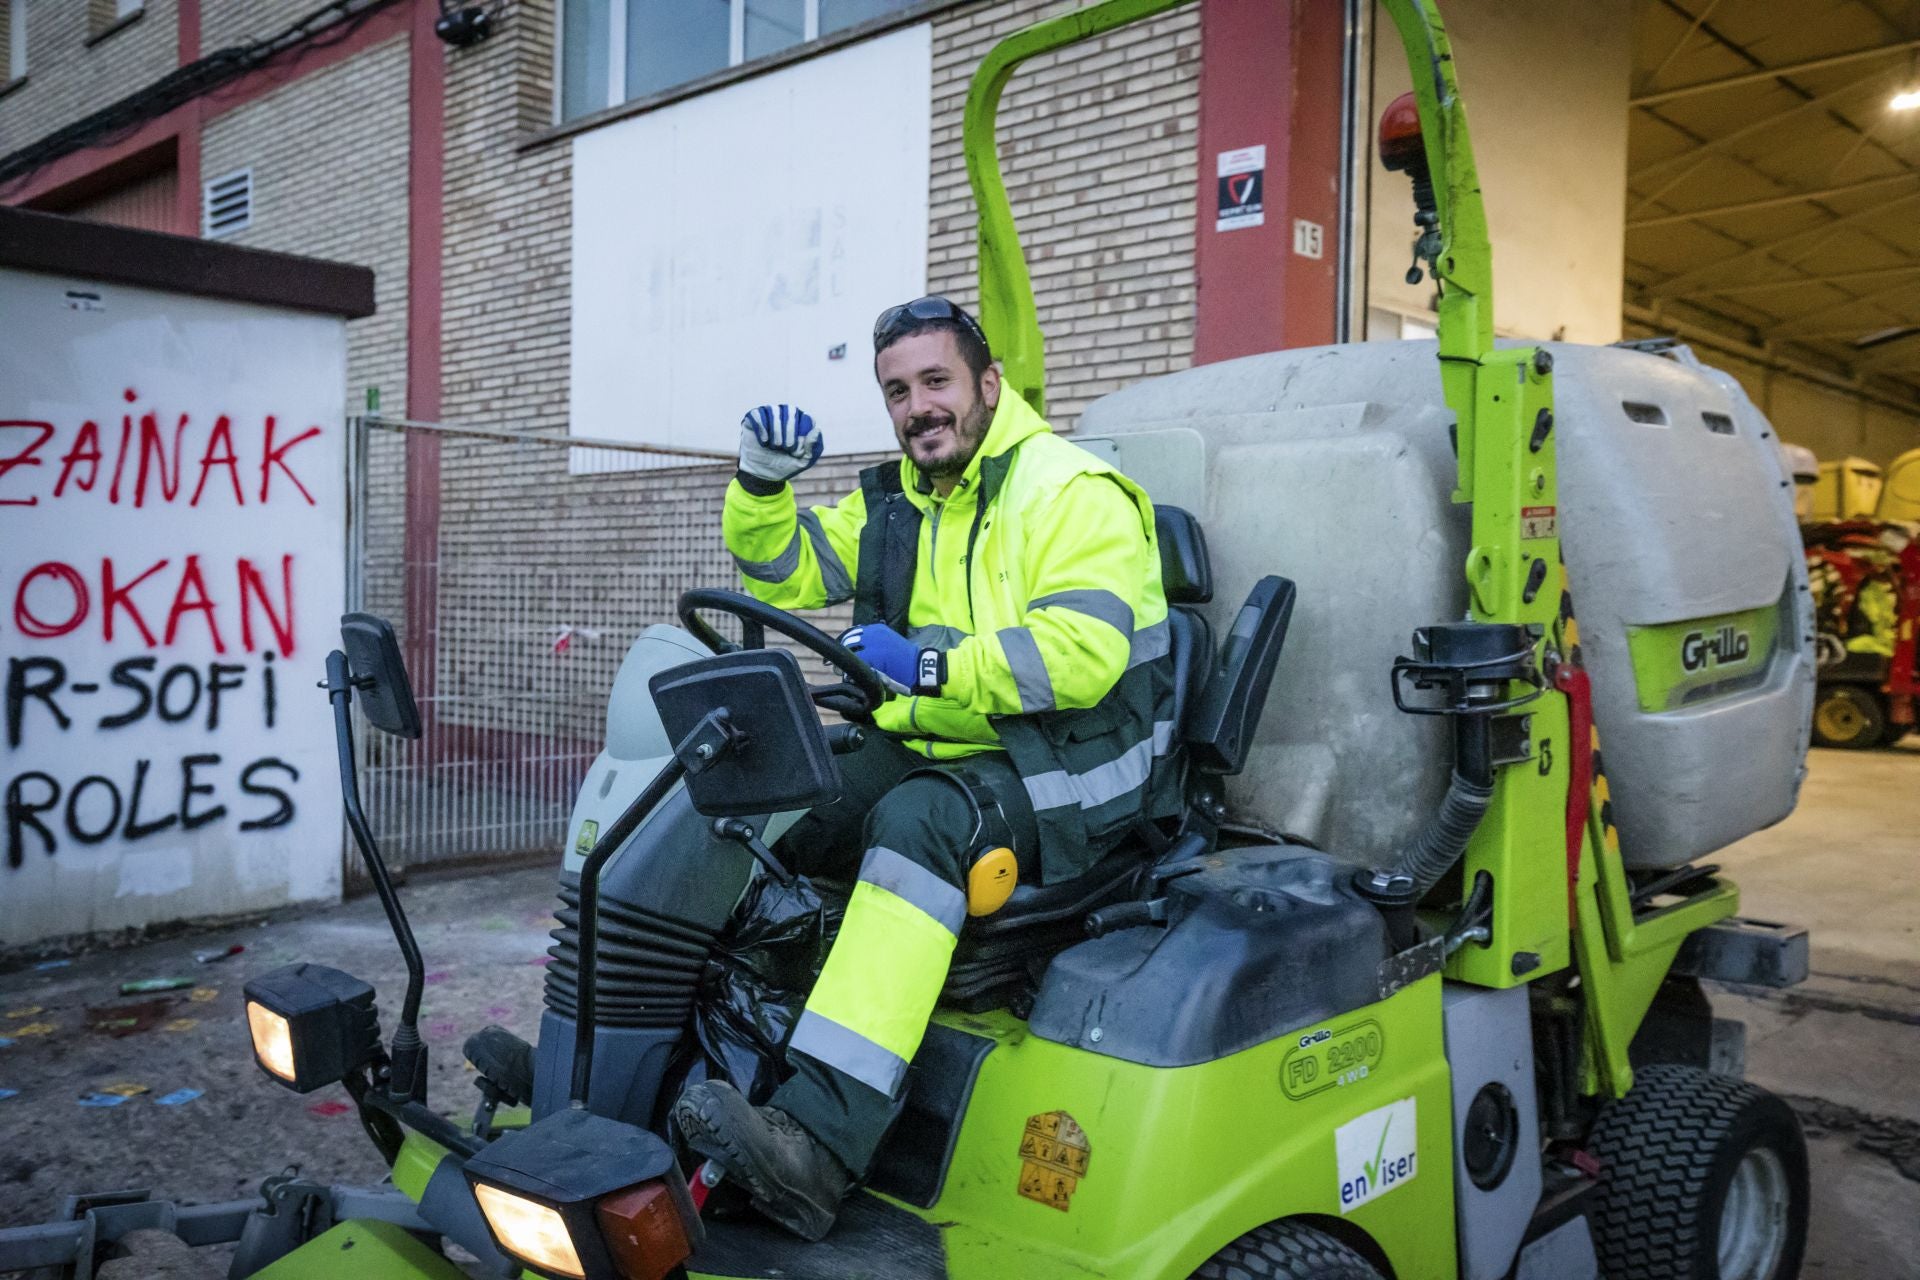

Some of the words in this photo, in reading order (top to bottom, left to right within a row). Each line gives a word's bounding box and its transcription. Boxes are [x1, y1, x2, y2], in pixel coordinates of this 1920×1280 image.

[14, 554, 297, 660] OKAN
[1682, 627, 1749, 671] Grillo
[6, 754, 299, 869] ROLES
[1288, 1055, 1319, 1089] FD
[1327, 1031, 1379, 1074] 2200
[1299, 1030, 1332, 1048] Grillo
